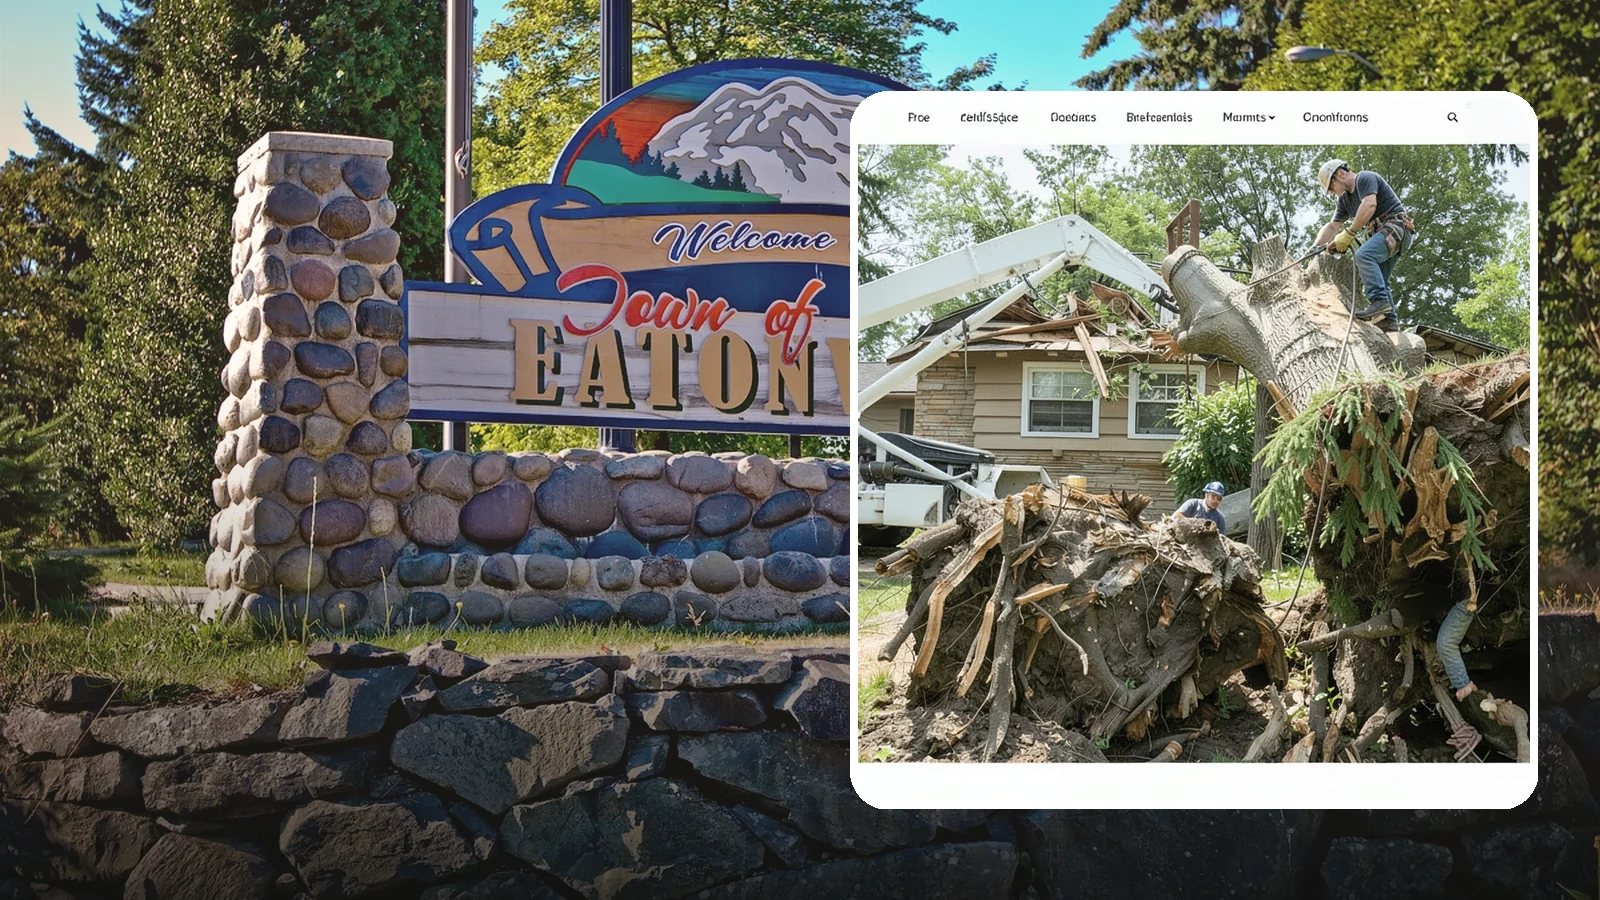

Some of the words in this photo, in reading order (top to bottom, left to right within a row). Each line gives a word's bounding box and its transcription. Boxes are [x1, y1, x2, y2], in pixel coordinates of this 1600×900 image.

[654, 221, 837, 263] Welcome
[557, 263, 737, 336] Town
[765, 279, 826, 365] of
